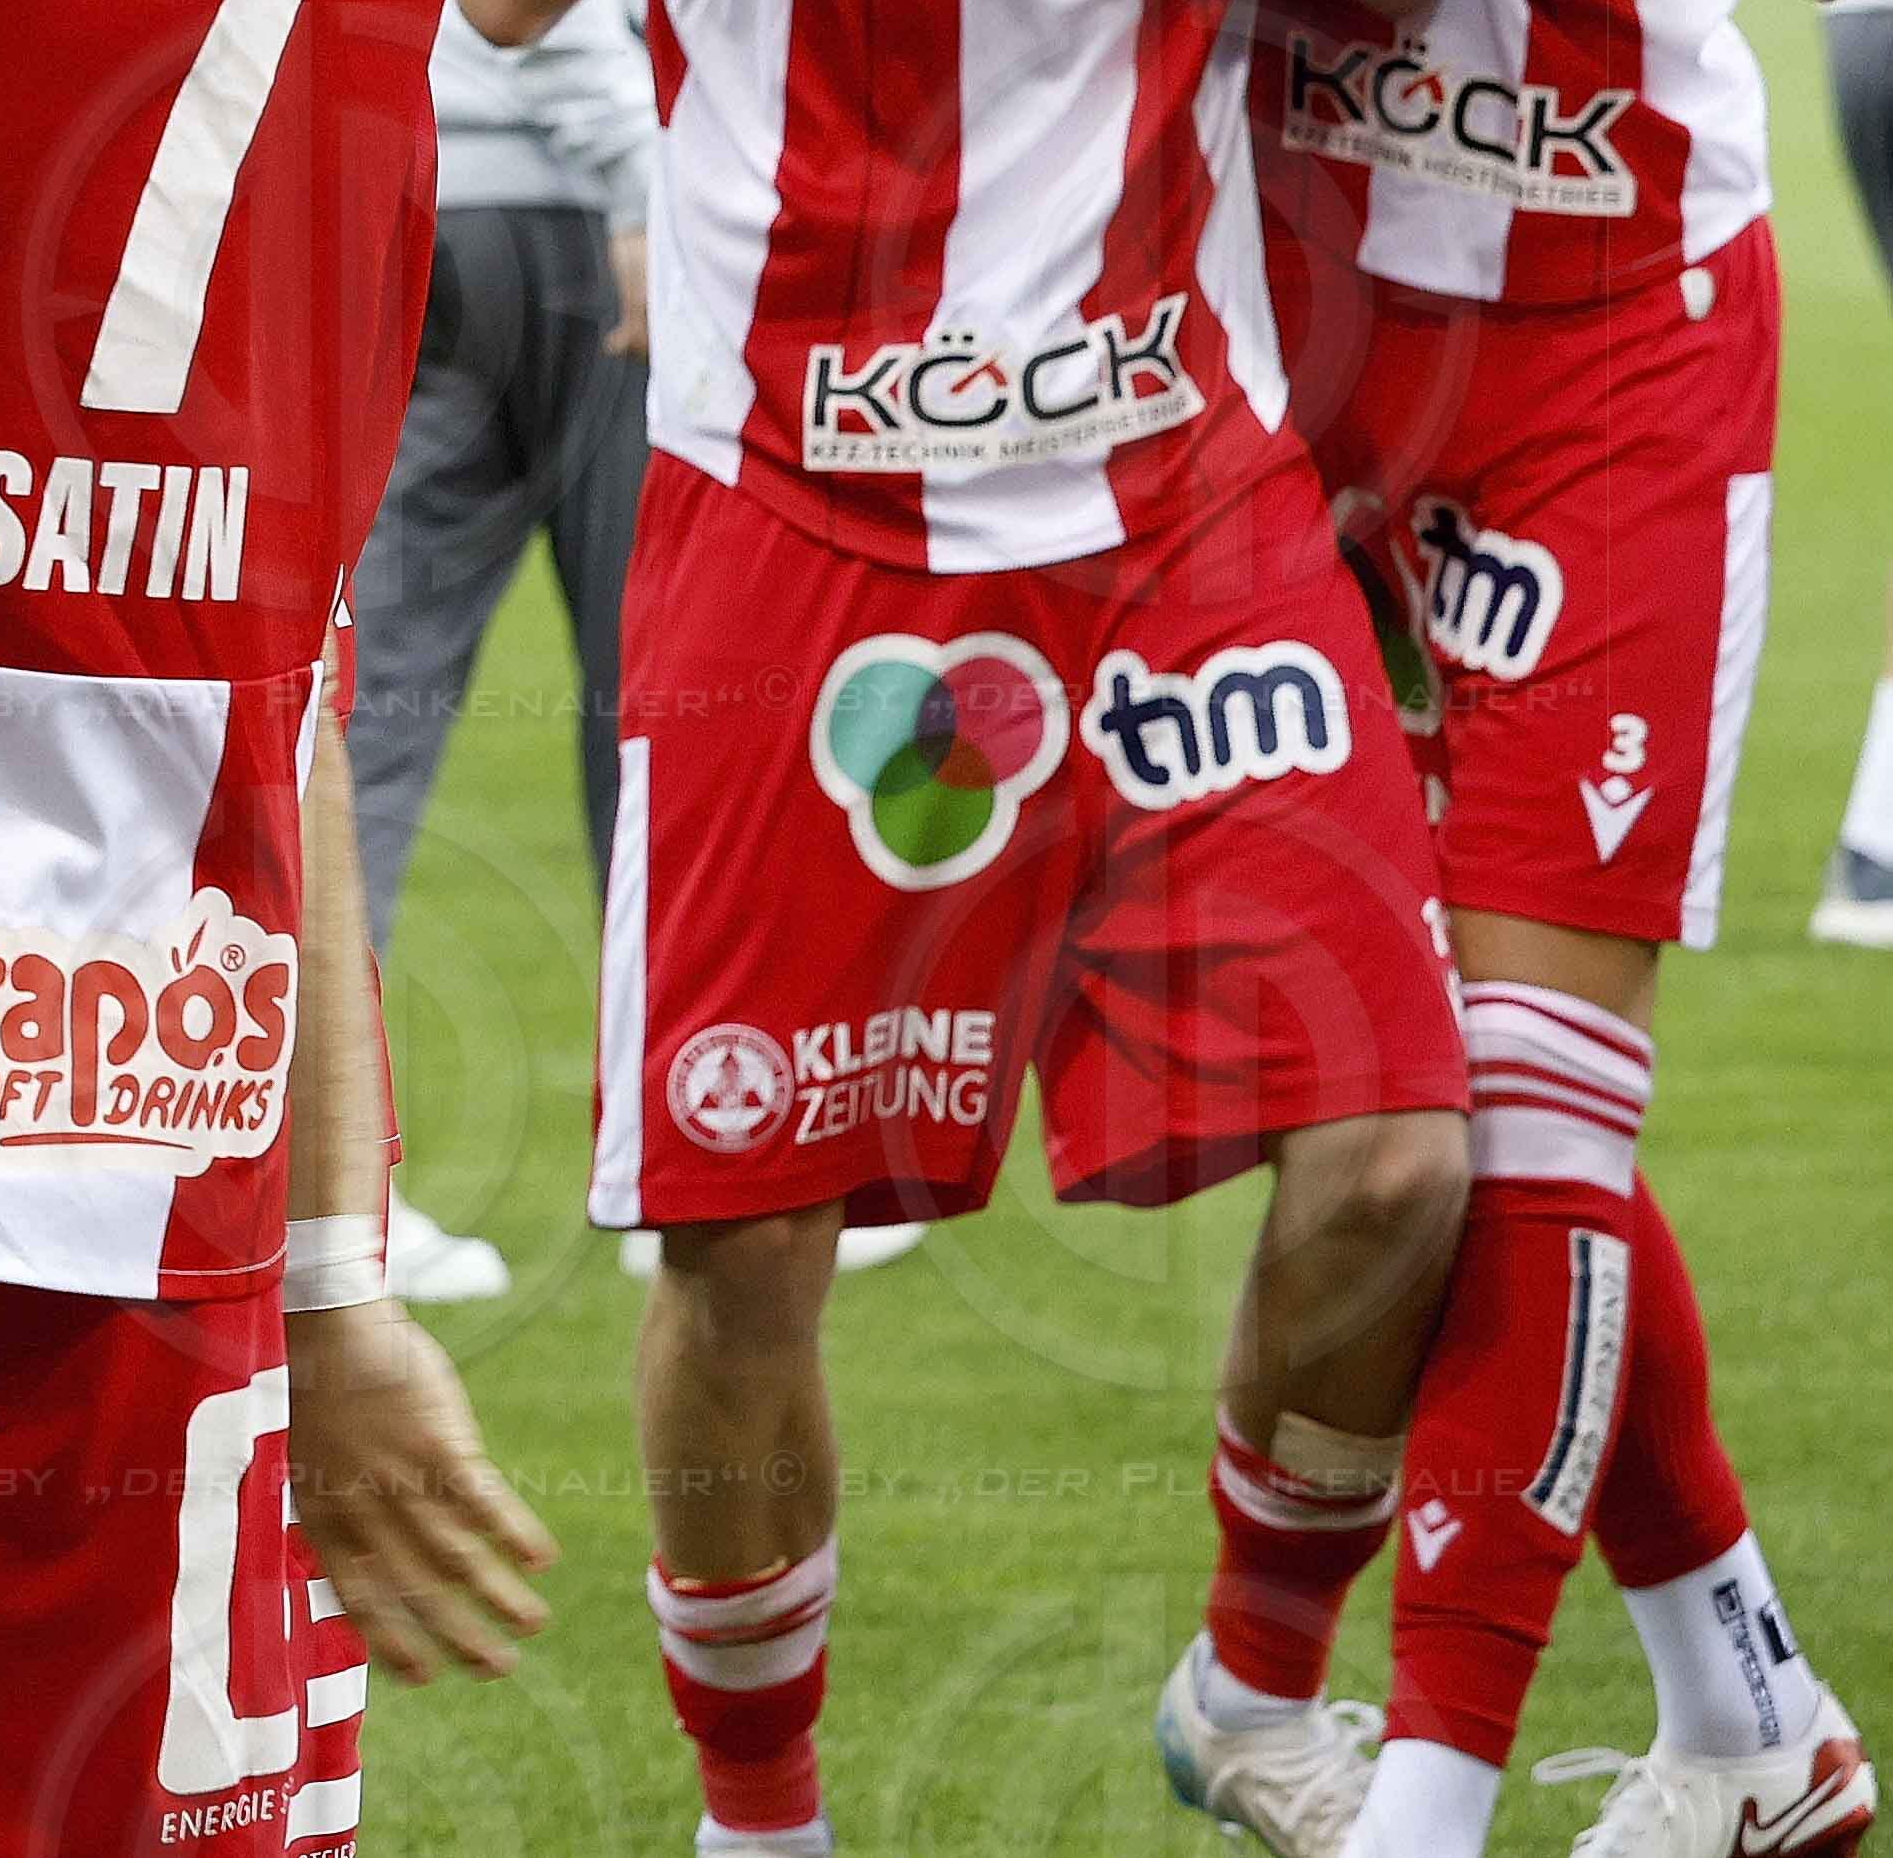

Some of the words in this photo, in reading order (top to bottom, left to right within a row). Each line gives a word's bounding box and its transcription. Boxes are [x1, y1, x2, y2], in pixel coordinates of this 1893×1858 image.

[1293, 37, 1617, 175] KÖCK
[813, 309, 1178, 430] KÖCK
[1601, 712, 1650, 774] 3
[791, 1005, 997, 1083] KLEINE
[100, 1071, 275, 1132] DRINKS
[160, 1789, 276, 1844] ENERGIE
